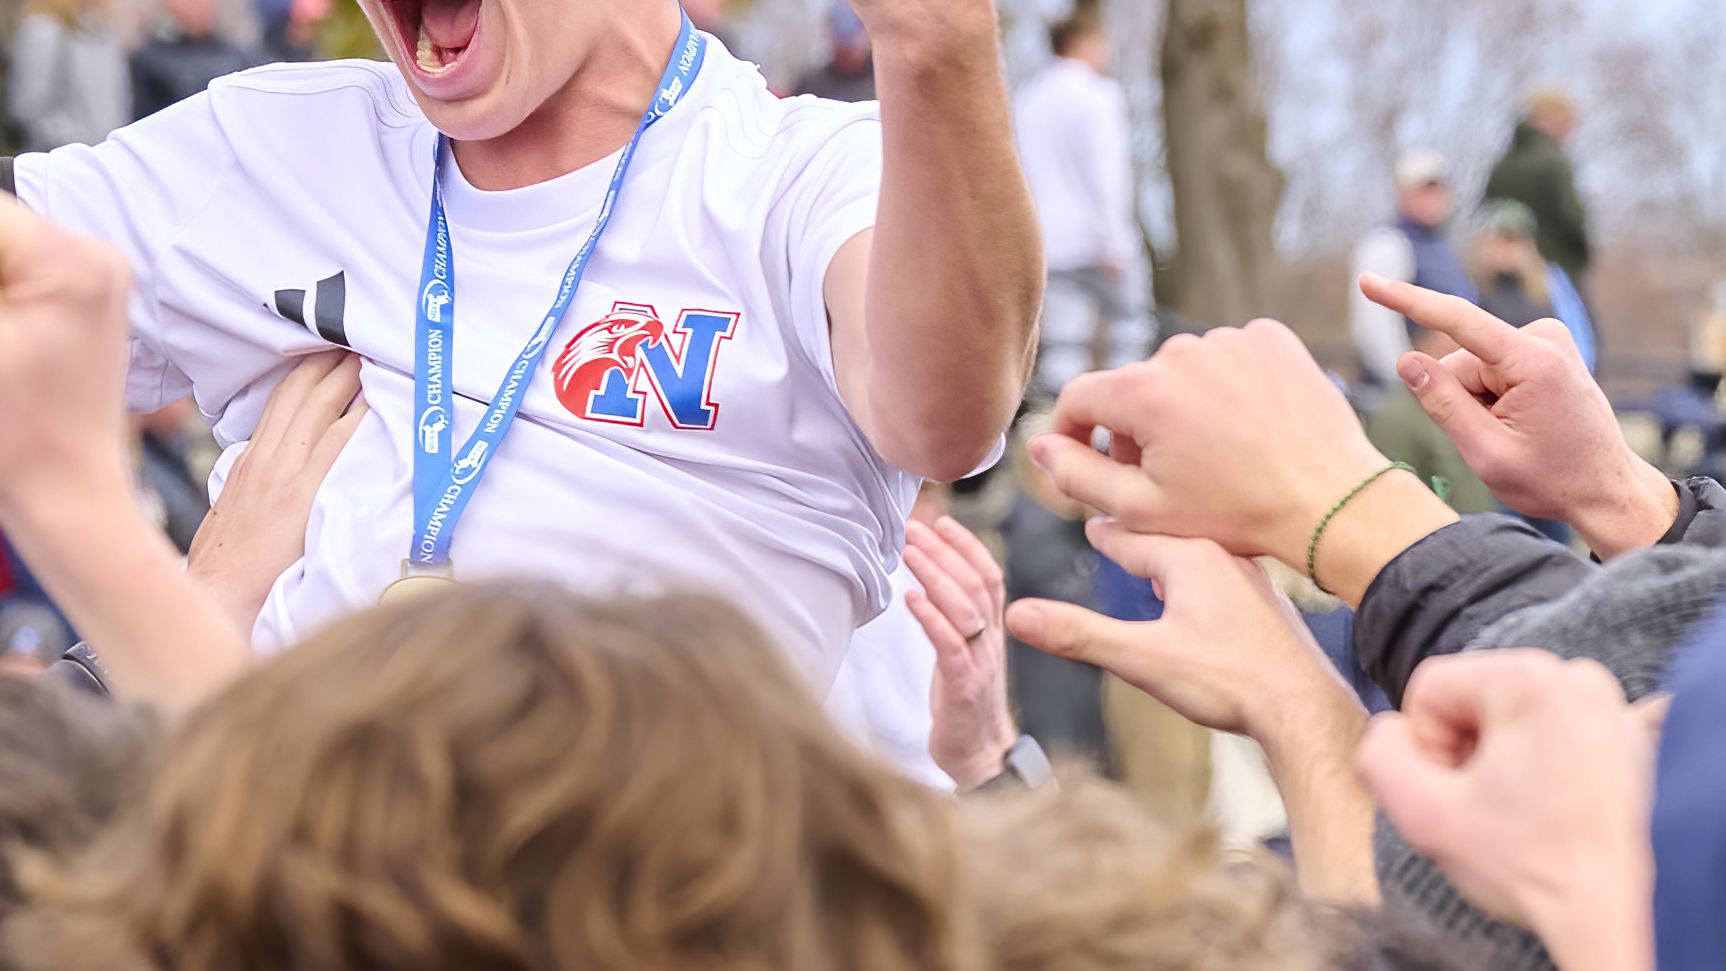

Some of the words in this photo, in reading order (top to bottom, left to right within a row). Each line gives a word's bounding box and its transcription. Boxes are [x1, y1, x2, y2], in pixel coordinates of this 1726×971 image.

[427, 328, 444, 405] CHAMPION
[483, 359, 530, 434] CHAMPION
[420, 484, 462, 565] CHAMPION
